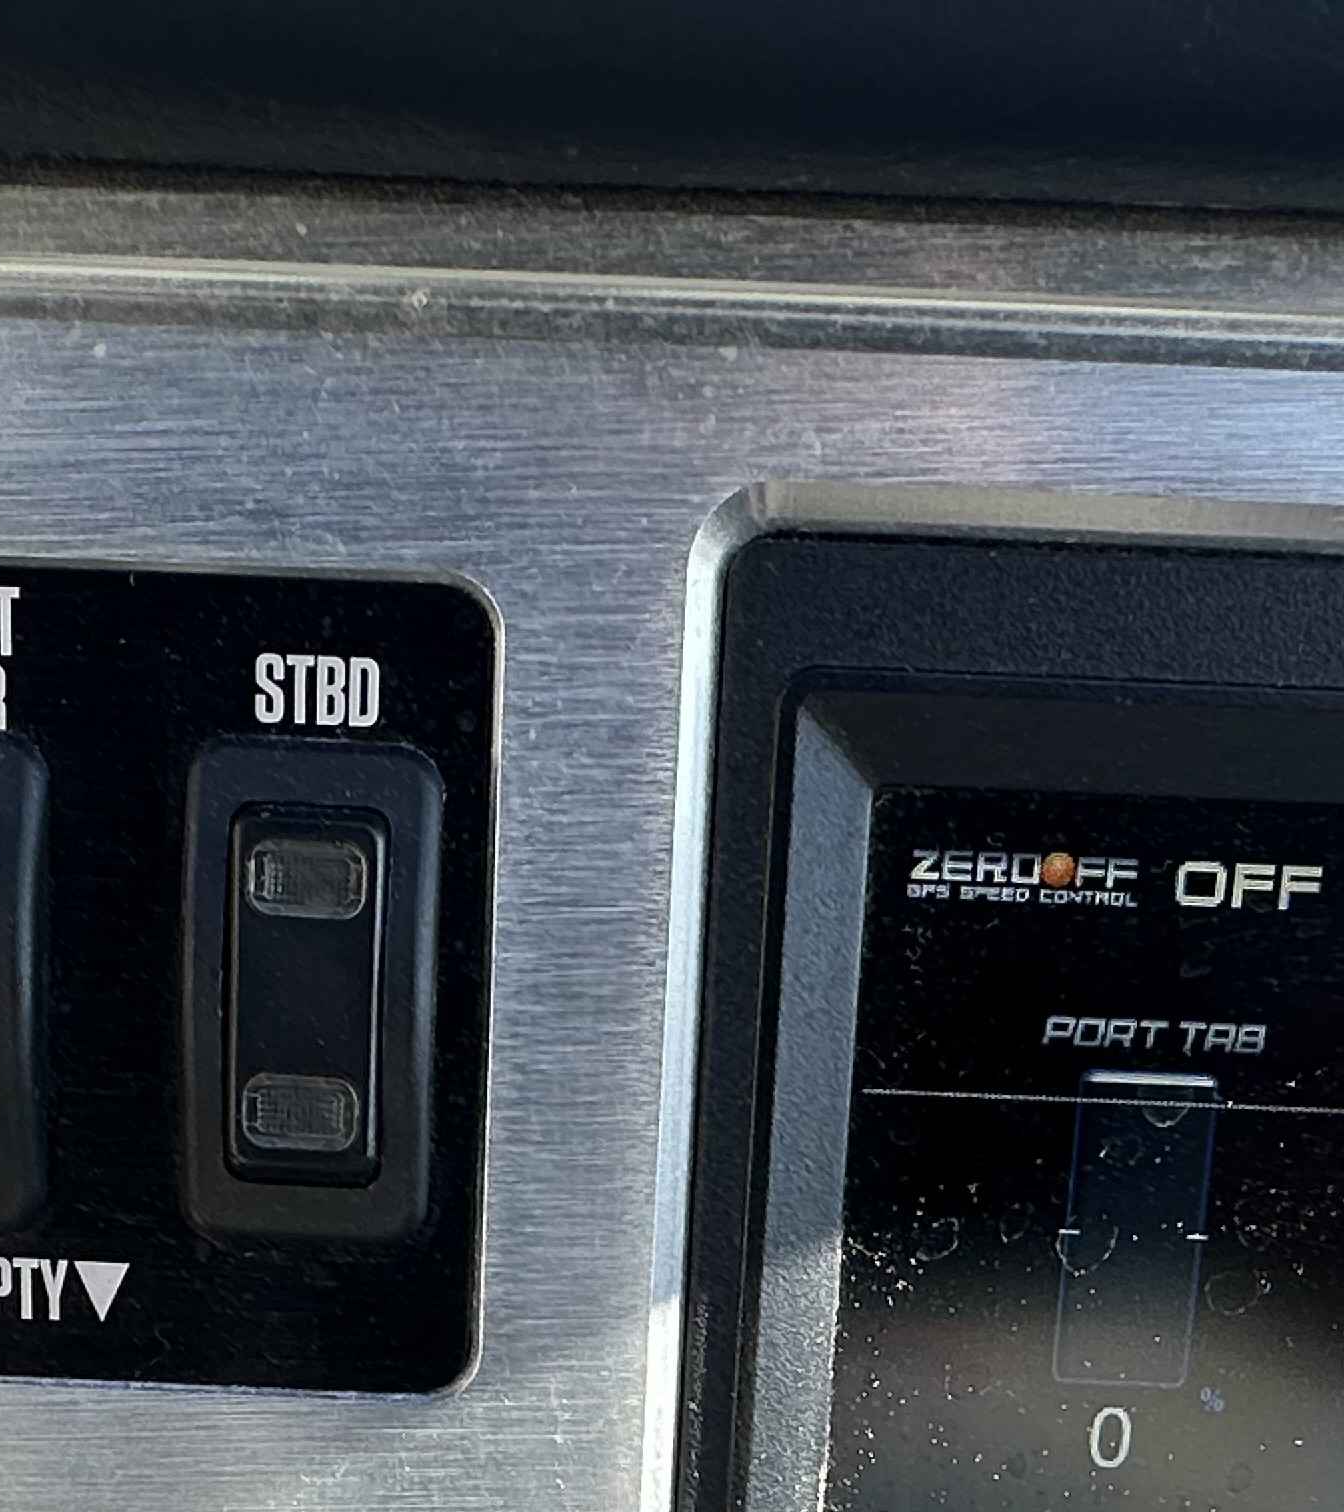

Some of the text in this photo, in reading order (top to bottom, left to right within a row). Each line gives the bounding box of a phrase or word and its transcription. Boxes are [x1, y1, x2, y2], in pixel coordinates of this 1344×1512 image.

[253, 653, 380, 728] STBD
[959, 885, 1030, 902] SPEED
[1039, 888, 1138, 908] CONTROL
[1175, 860, 1324, 910] OFF
[1041, 1015, 1267, 1054] PORT TAB
[1090, 1406, 1132, 1468] 0
